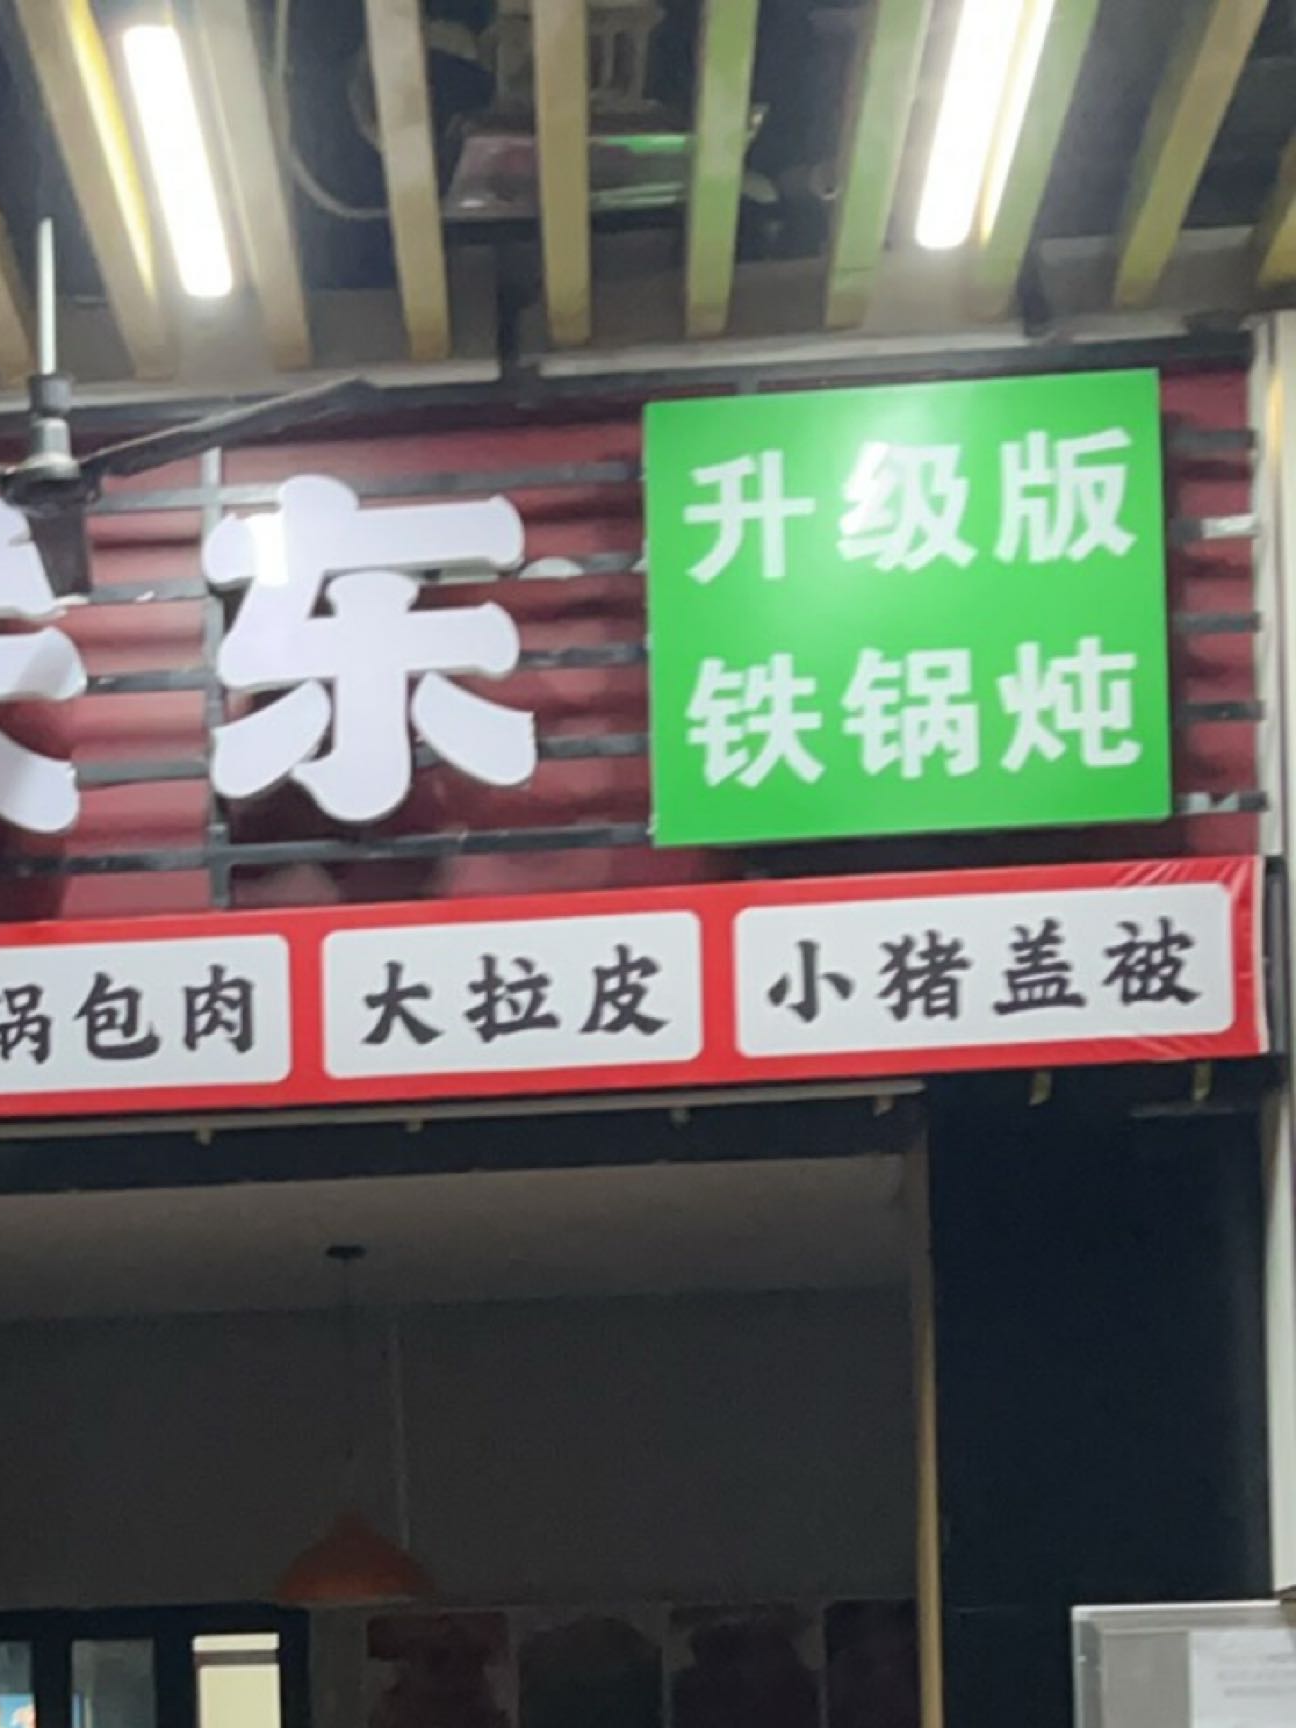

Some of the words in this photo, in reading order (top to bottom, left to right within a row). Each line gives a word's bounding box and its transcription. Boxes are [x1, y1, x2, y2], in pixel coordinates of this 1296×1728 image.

[683, 426, 1137, 584] 升级版
[685, 637, 1142, 788] 铁锅炖
[360, 945, 671, 1046] 大拉皮
[767, 916, 1203, 1022] 小猪盖被
